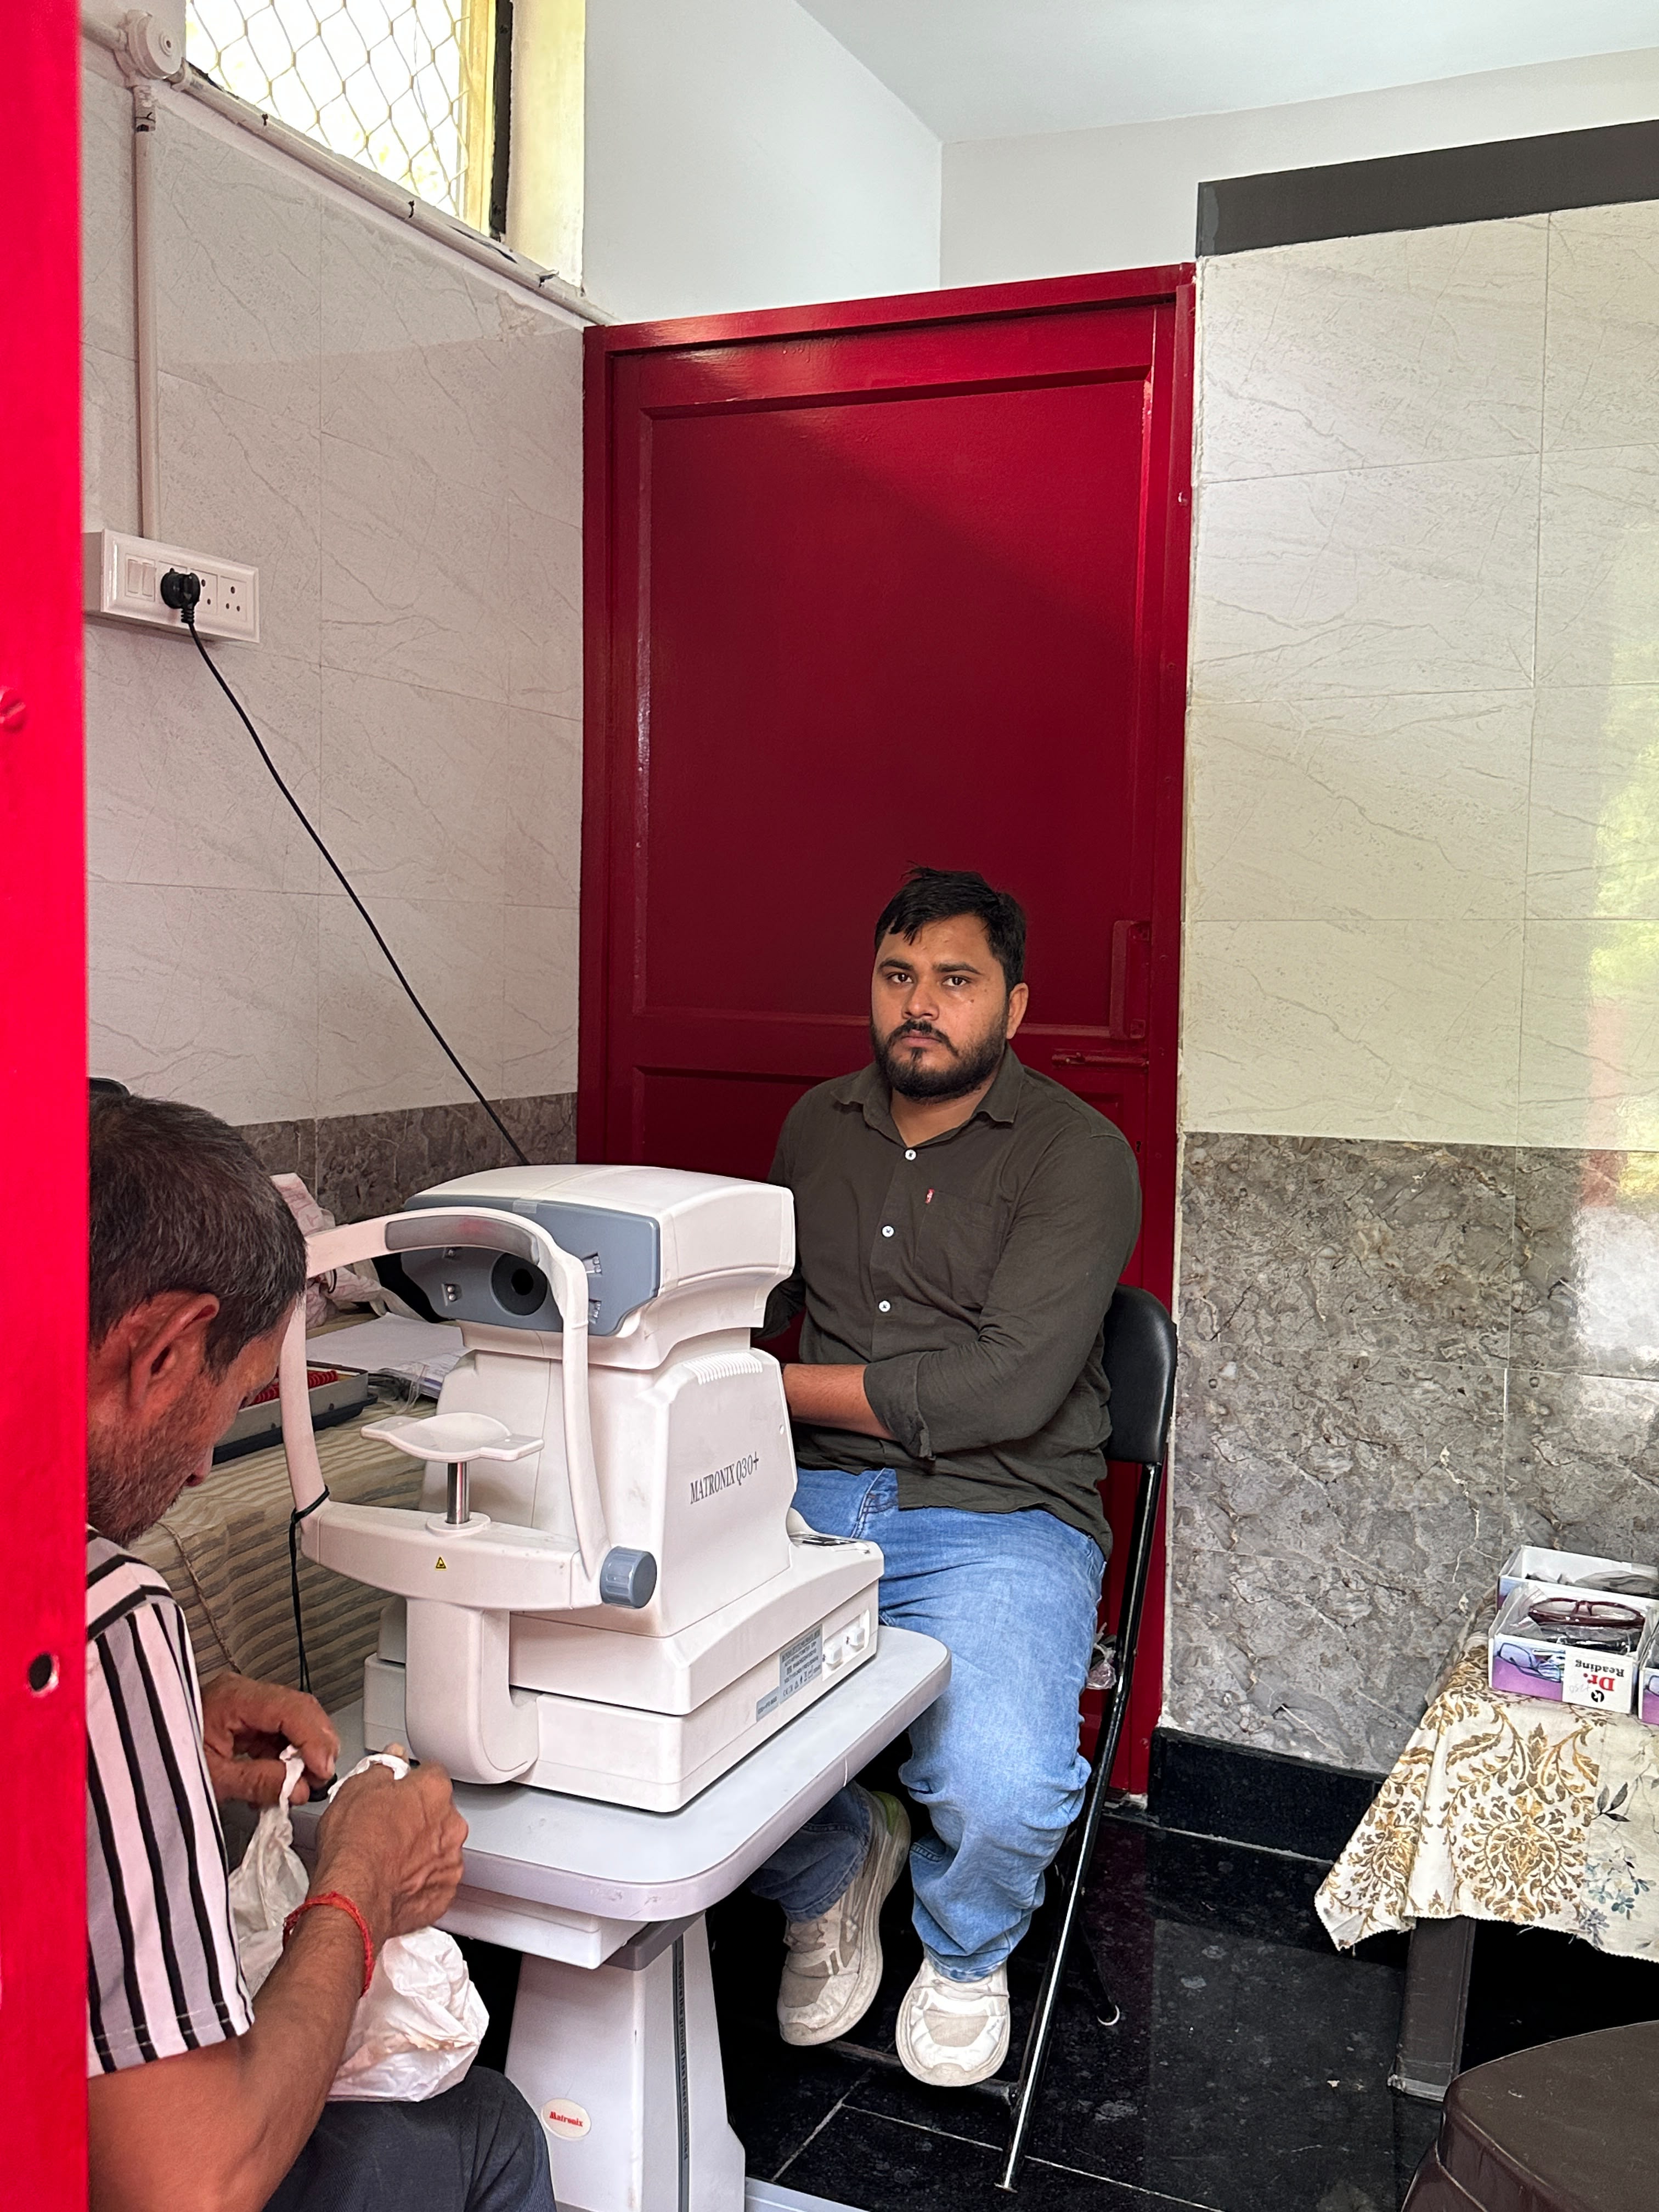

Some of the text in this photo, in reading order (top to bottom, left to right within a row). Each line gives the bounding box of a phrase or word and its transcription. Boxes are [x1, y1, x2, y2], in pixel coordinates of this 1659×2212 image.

[690, 1451, 759, 1505] MATRONIX Q30+
[1575, 1659, 1624, 1677] Reading
[1583, 1673, 1615, 1691] Dr.
[549, 2111, 583, 2127] Matronix
